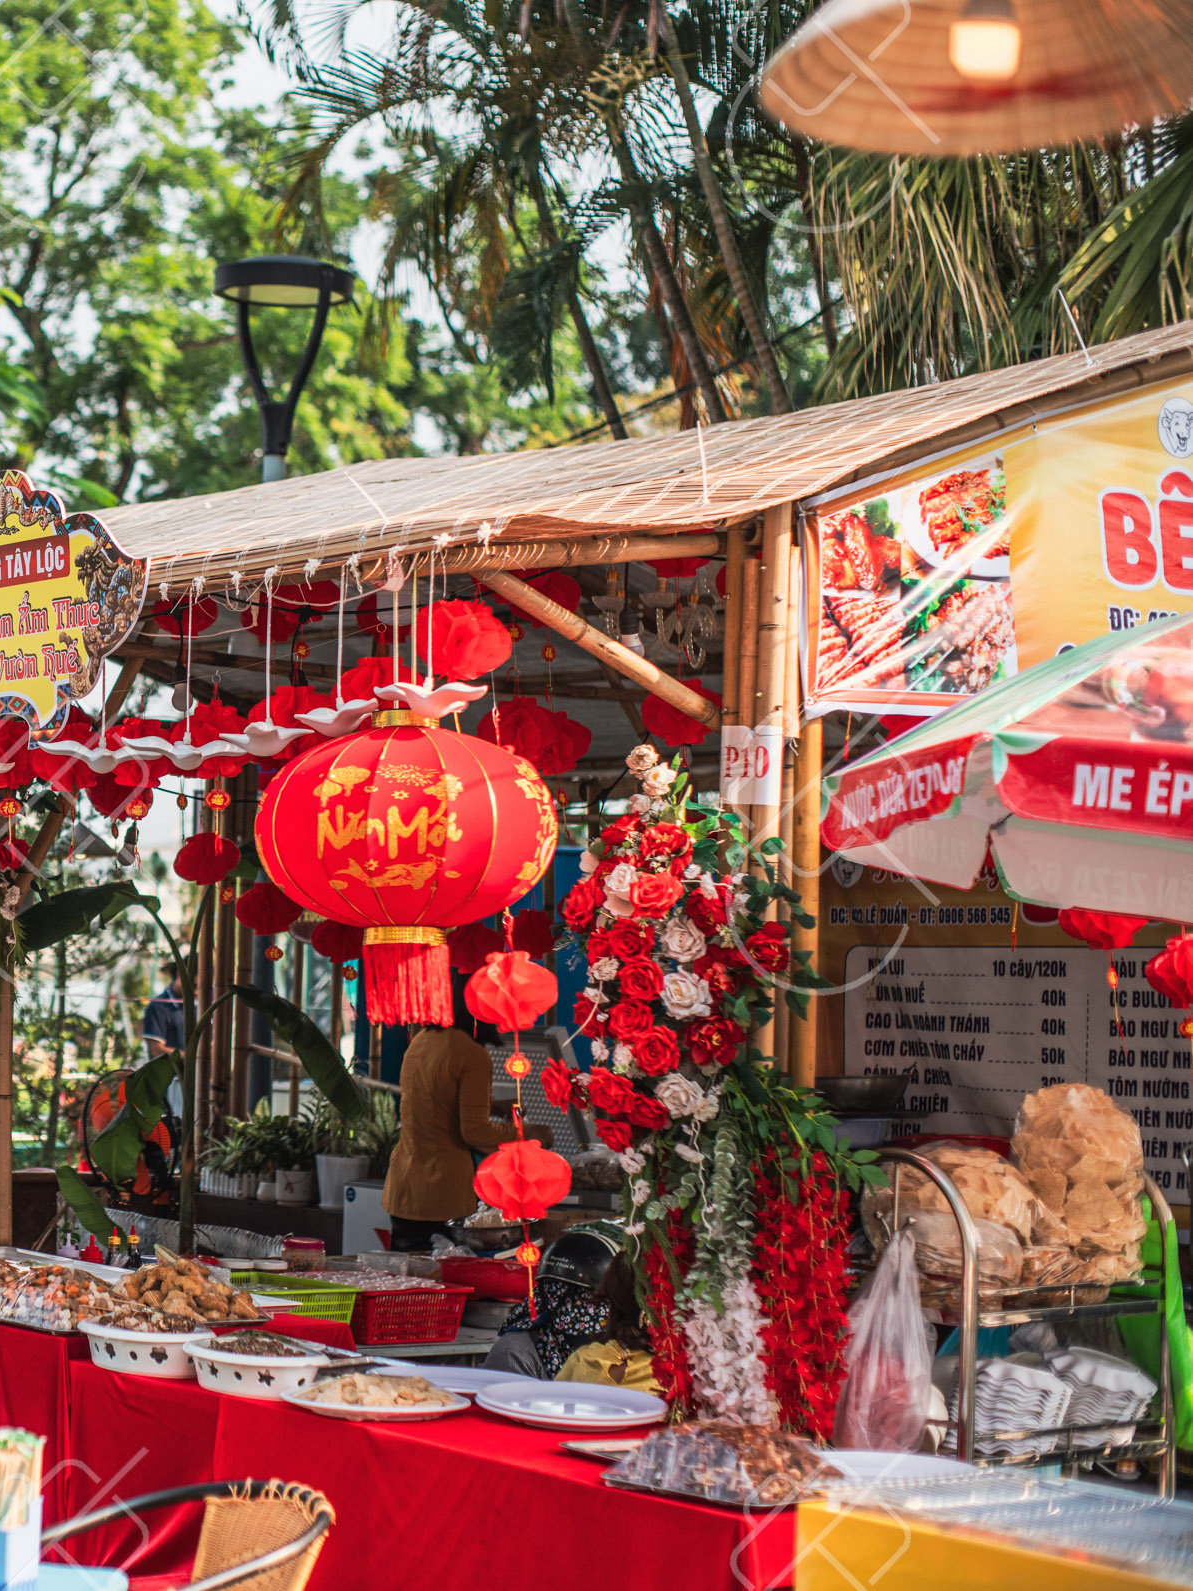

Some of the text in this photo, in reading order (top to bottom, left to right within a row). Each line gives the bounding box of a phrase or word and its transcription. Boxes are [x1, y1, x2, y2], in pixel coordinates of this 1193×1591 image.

[5, 548, 32, 578] TÂY
[36, 542, 66, 579] LỘC
[51, 598, 101, 637] Thực
[723, 745, 770, 779] P10
[1072, 764, 1135, 811] ME
[938, 907, 964, 924] 0906
[990, 907, 1011, 924] 545
[993, 960, 1006, 977] 10
[905, 980, 925, 1004] HUẾ
[866, 1012, 892, 1029] CAO
[950, 1013, 990, 1034] THÁNH
[1141, 1019, 1170, 1038] NGƯ
[864, 1040, 896, 1057] CƠM
[1109, 1046, 1136, 1068] BÀO
[1140, 1049, 1170, 1069] NGƯ
[1108, 1076, 1190, 1099] TÔM NƯỚNG
[910, 1093, 949, 1113] CHIÊN
